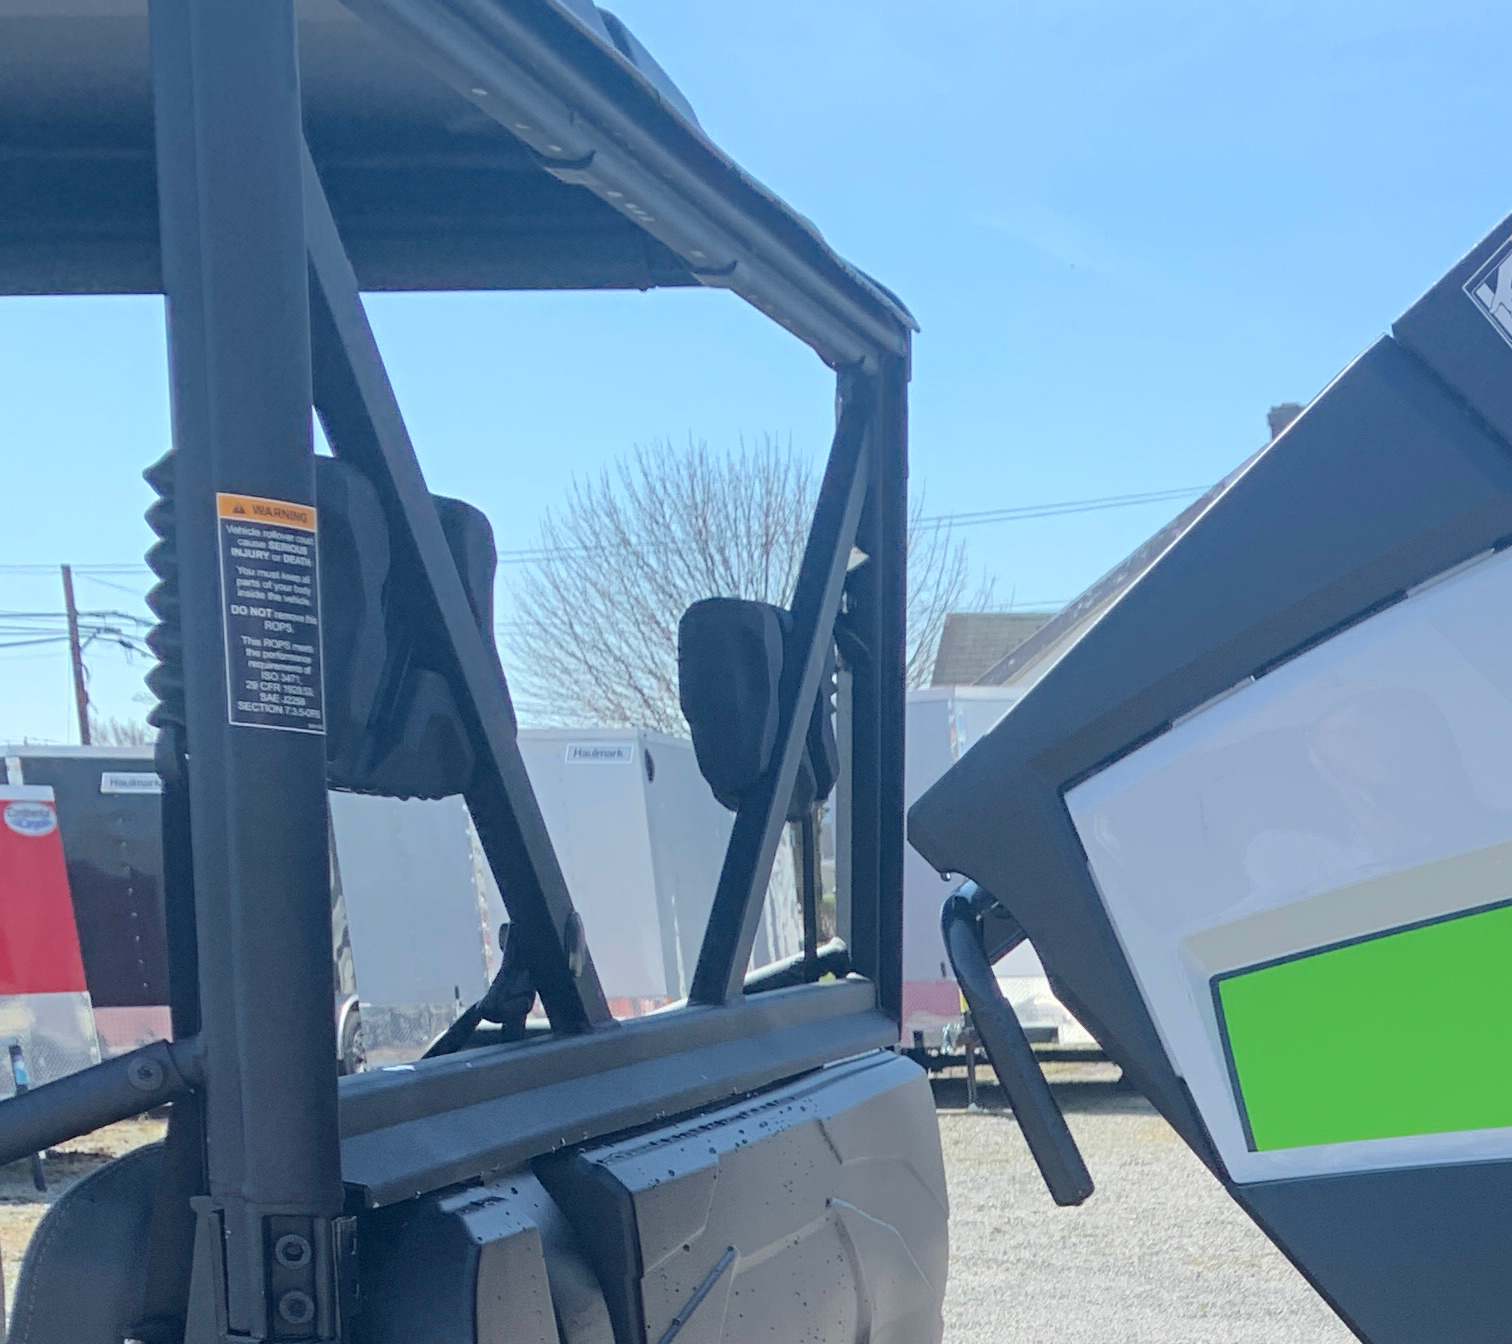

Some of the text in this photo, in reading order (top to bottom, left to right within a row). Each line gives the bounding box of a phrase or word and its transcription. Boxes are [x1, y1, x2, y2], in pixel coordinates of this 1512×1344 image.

[252, 505, 307, 522] WARNING
[231, 547, 270, 560] INJURY
[268, 540, 308, 556] SERIOUS
[236, 565, 255, 576] You
[257, 570, 280, 580] must
[236, 578, 261, 589] parts
[262, 580, 273, 590] of
[267, 592, 282, 602] the
[231, 604, 248, 615] DO
[249, 606, 272, 618] NOT
[264, 620, 295, 633] ROPS.
[241, 635, 261, 647] This
[263, 638, 291, 650] ROPS
[245, 647, 261, 658] the
[261, 670, 279, 681] ISO
[260, 681, 281, 692] CFR
[259, 692, 280, 703] SAE
[238, 700, 283, 715] SECTION
[573, 747, 624, 759] Haulmark
